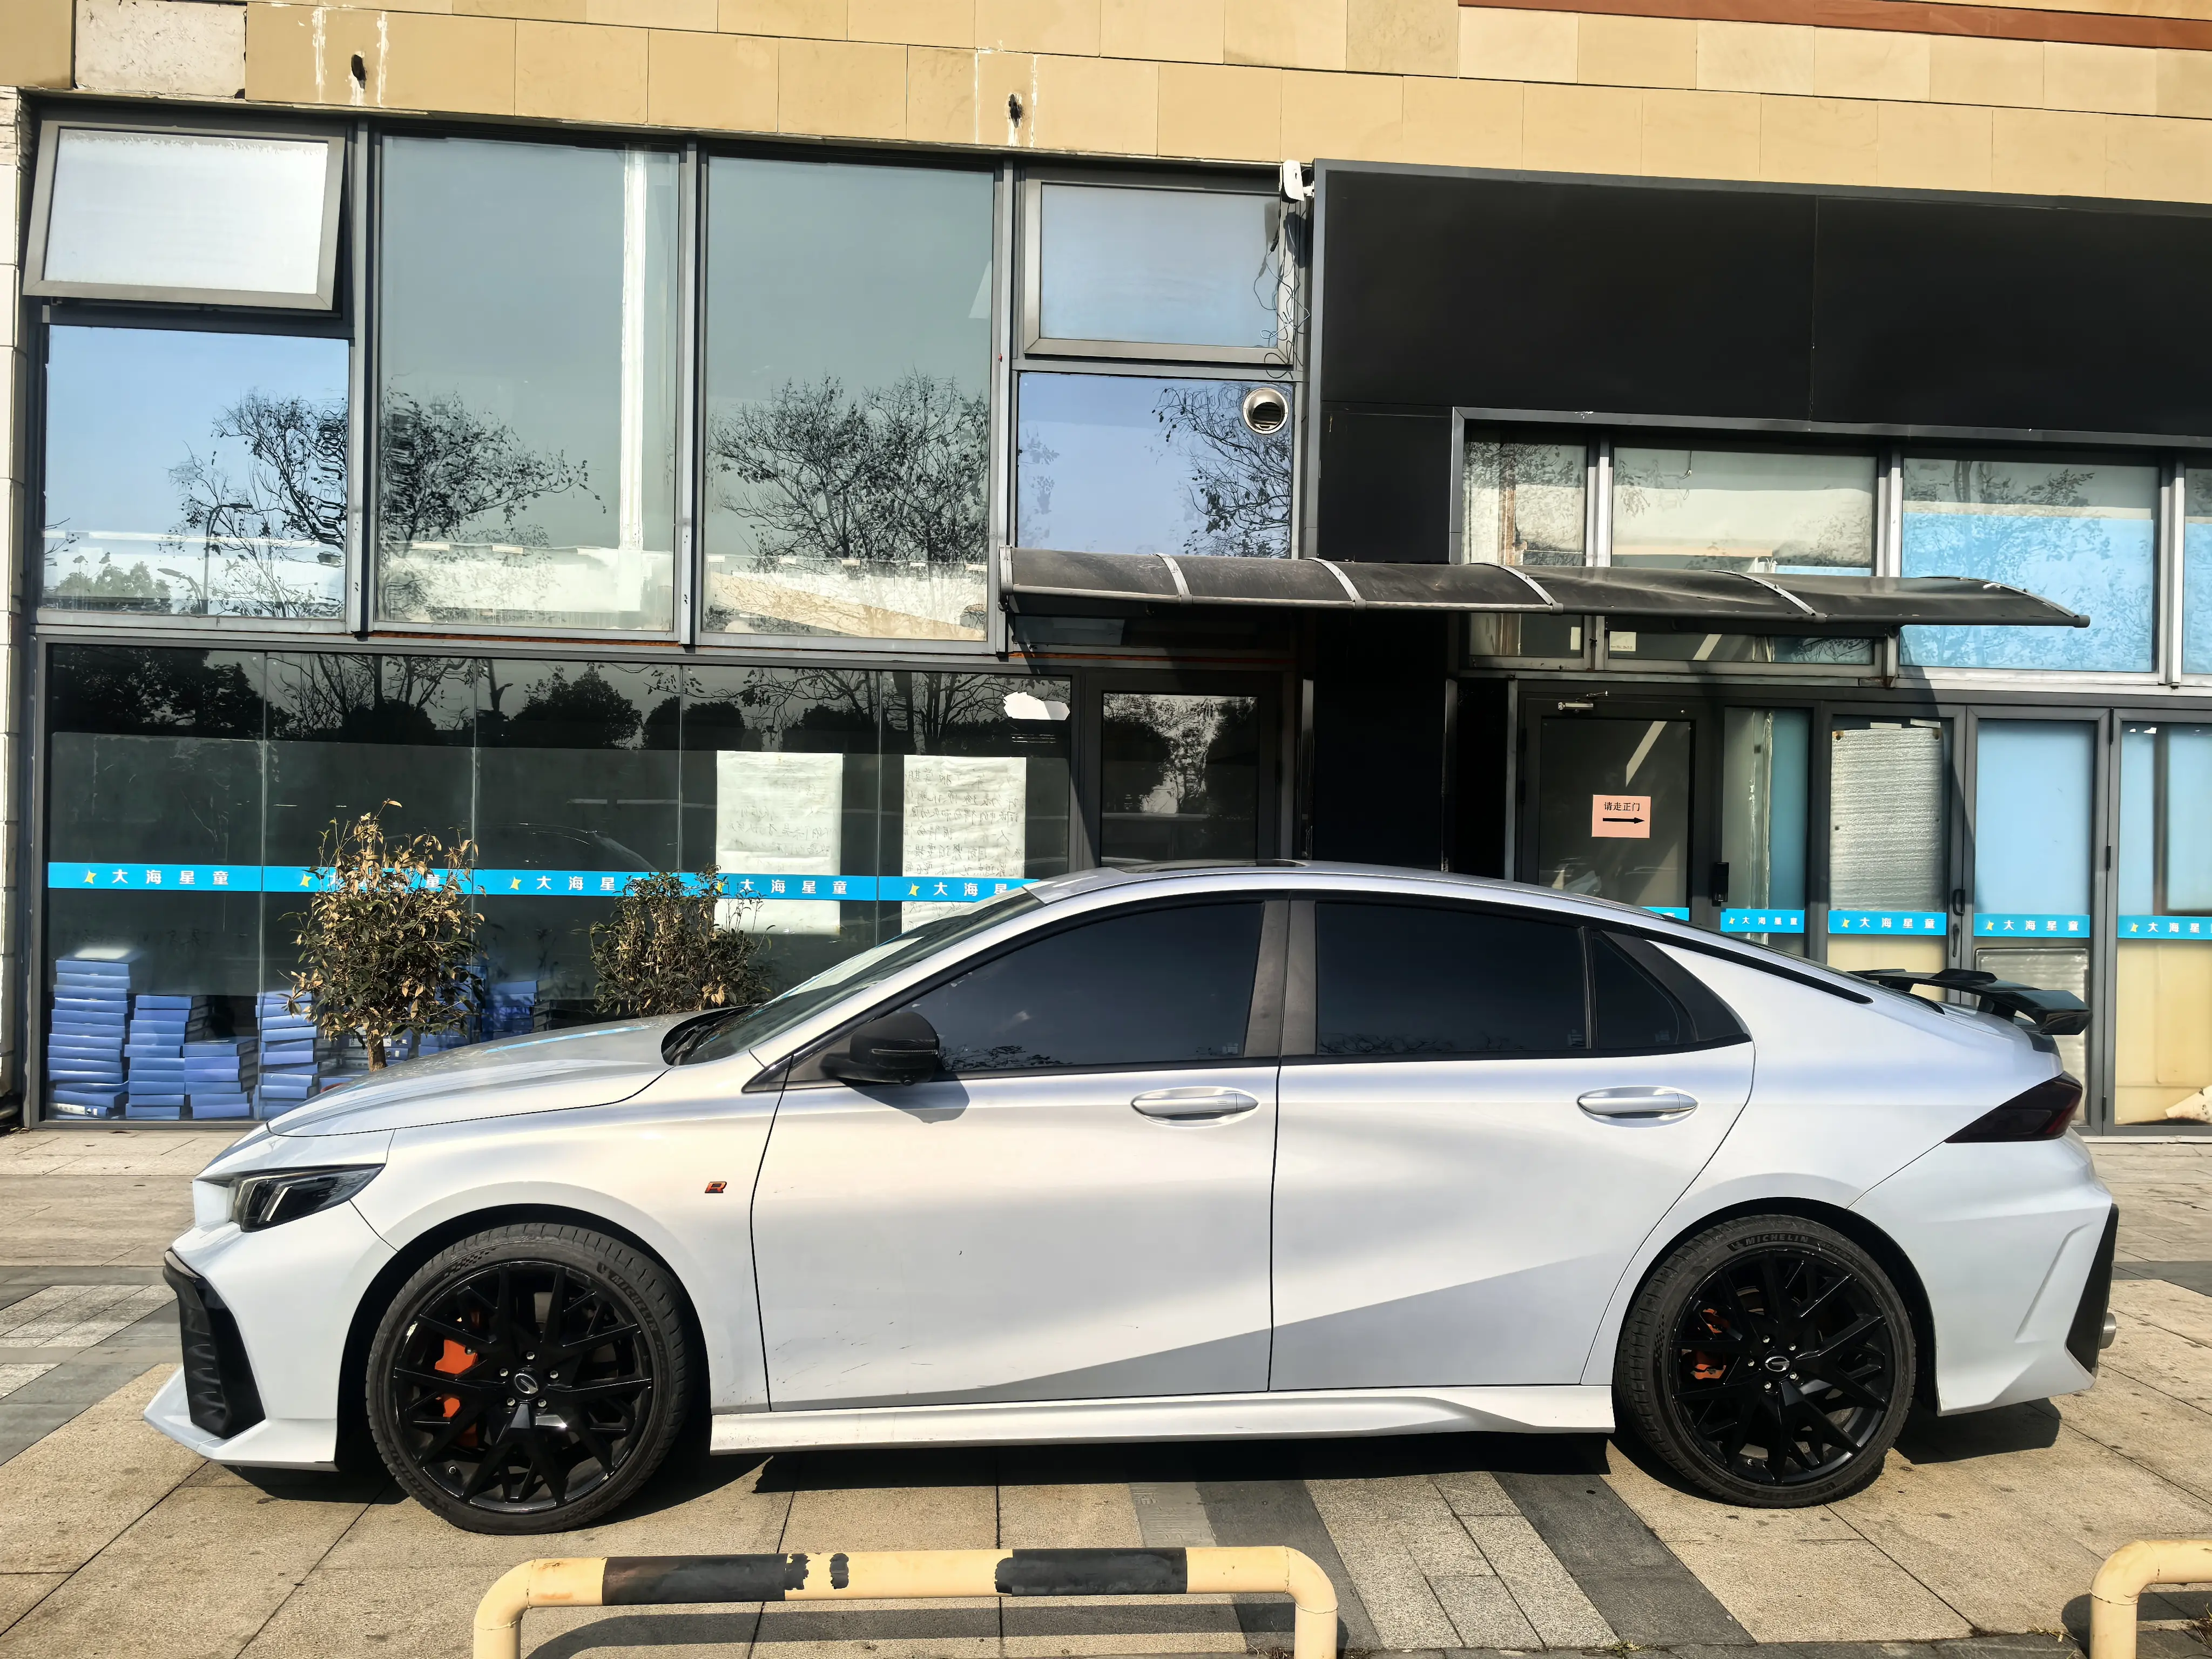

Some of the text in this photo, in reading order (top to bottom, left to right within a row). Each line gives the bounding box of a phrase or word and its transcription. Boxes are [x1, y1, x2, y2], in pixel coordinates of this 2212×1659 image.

[1604, 801, 1640, 812] 请走正门
[112, 869, 229, 886] 大海星童
[536, 875, 647, 891] 大海星
[739, 878, 847, 895] 大海星童
[1742, 916, 1798, 926] 大海星童
[1860, 917, 1935, 929] 大海星童
[2004, 920, 2079, 932] 大海星童
[2148, 922, 2212, 934] 大海星
[1745, 1233, 1809, 1244] MICHELIN
